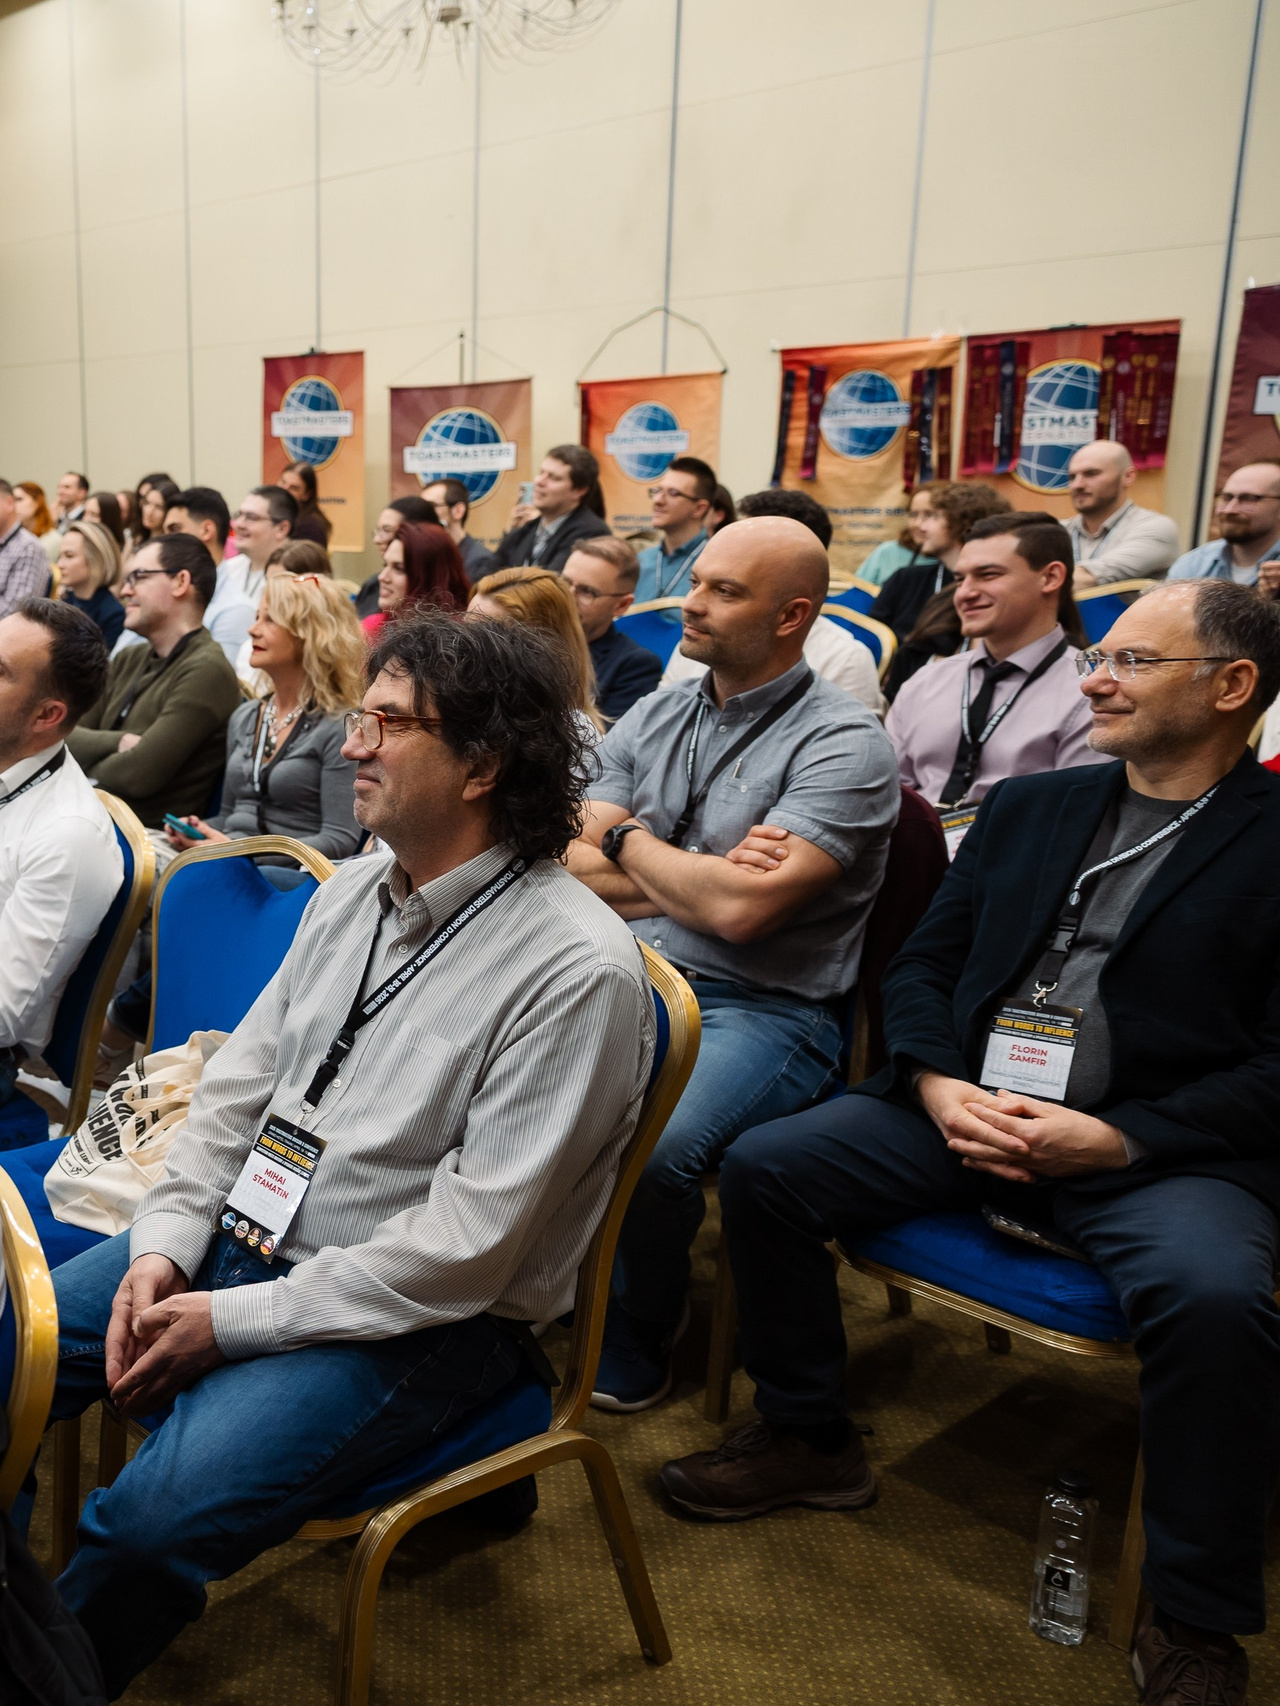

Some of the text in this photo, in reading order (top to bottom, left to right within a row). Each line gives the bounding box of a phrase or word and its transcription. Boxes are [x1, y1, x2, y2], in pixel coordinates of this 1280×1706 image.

[409, 448, 511, 460] TOASTMASTERS
[473, 869, 514, 908] TOASTMASTERS
[450, 904, 476, 929] DIVISION
[412, 931, 450, 965] CONFERENCE
[397, 964, 416, 982] APRIL
[1011, 1044, 1048, 1057] FLORIN
[1008, 1053, 1047, 1067] ZAMFIR
[264, 1168, 287, 1186] MIHAI
[252, 1174, 290, 1200] STAMATIN
